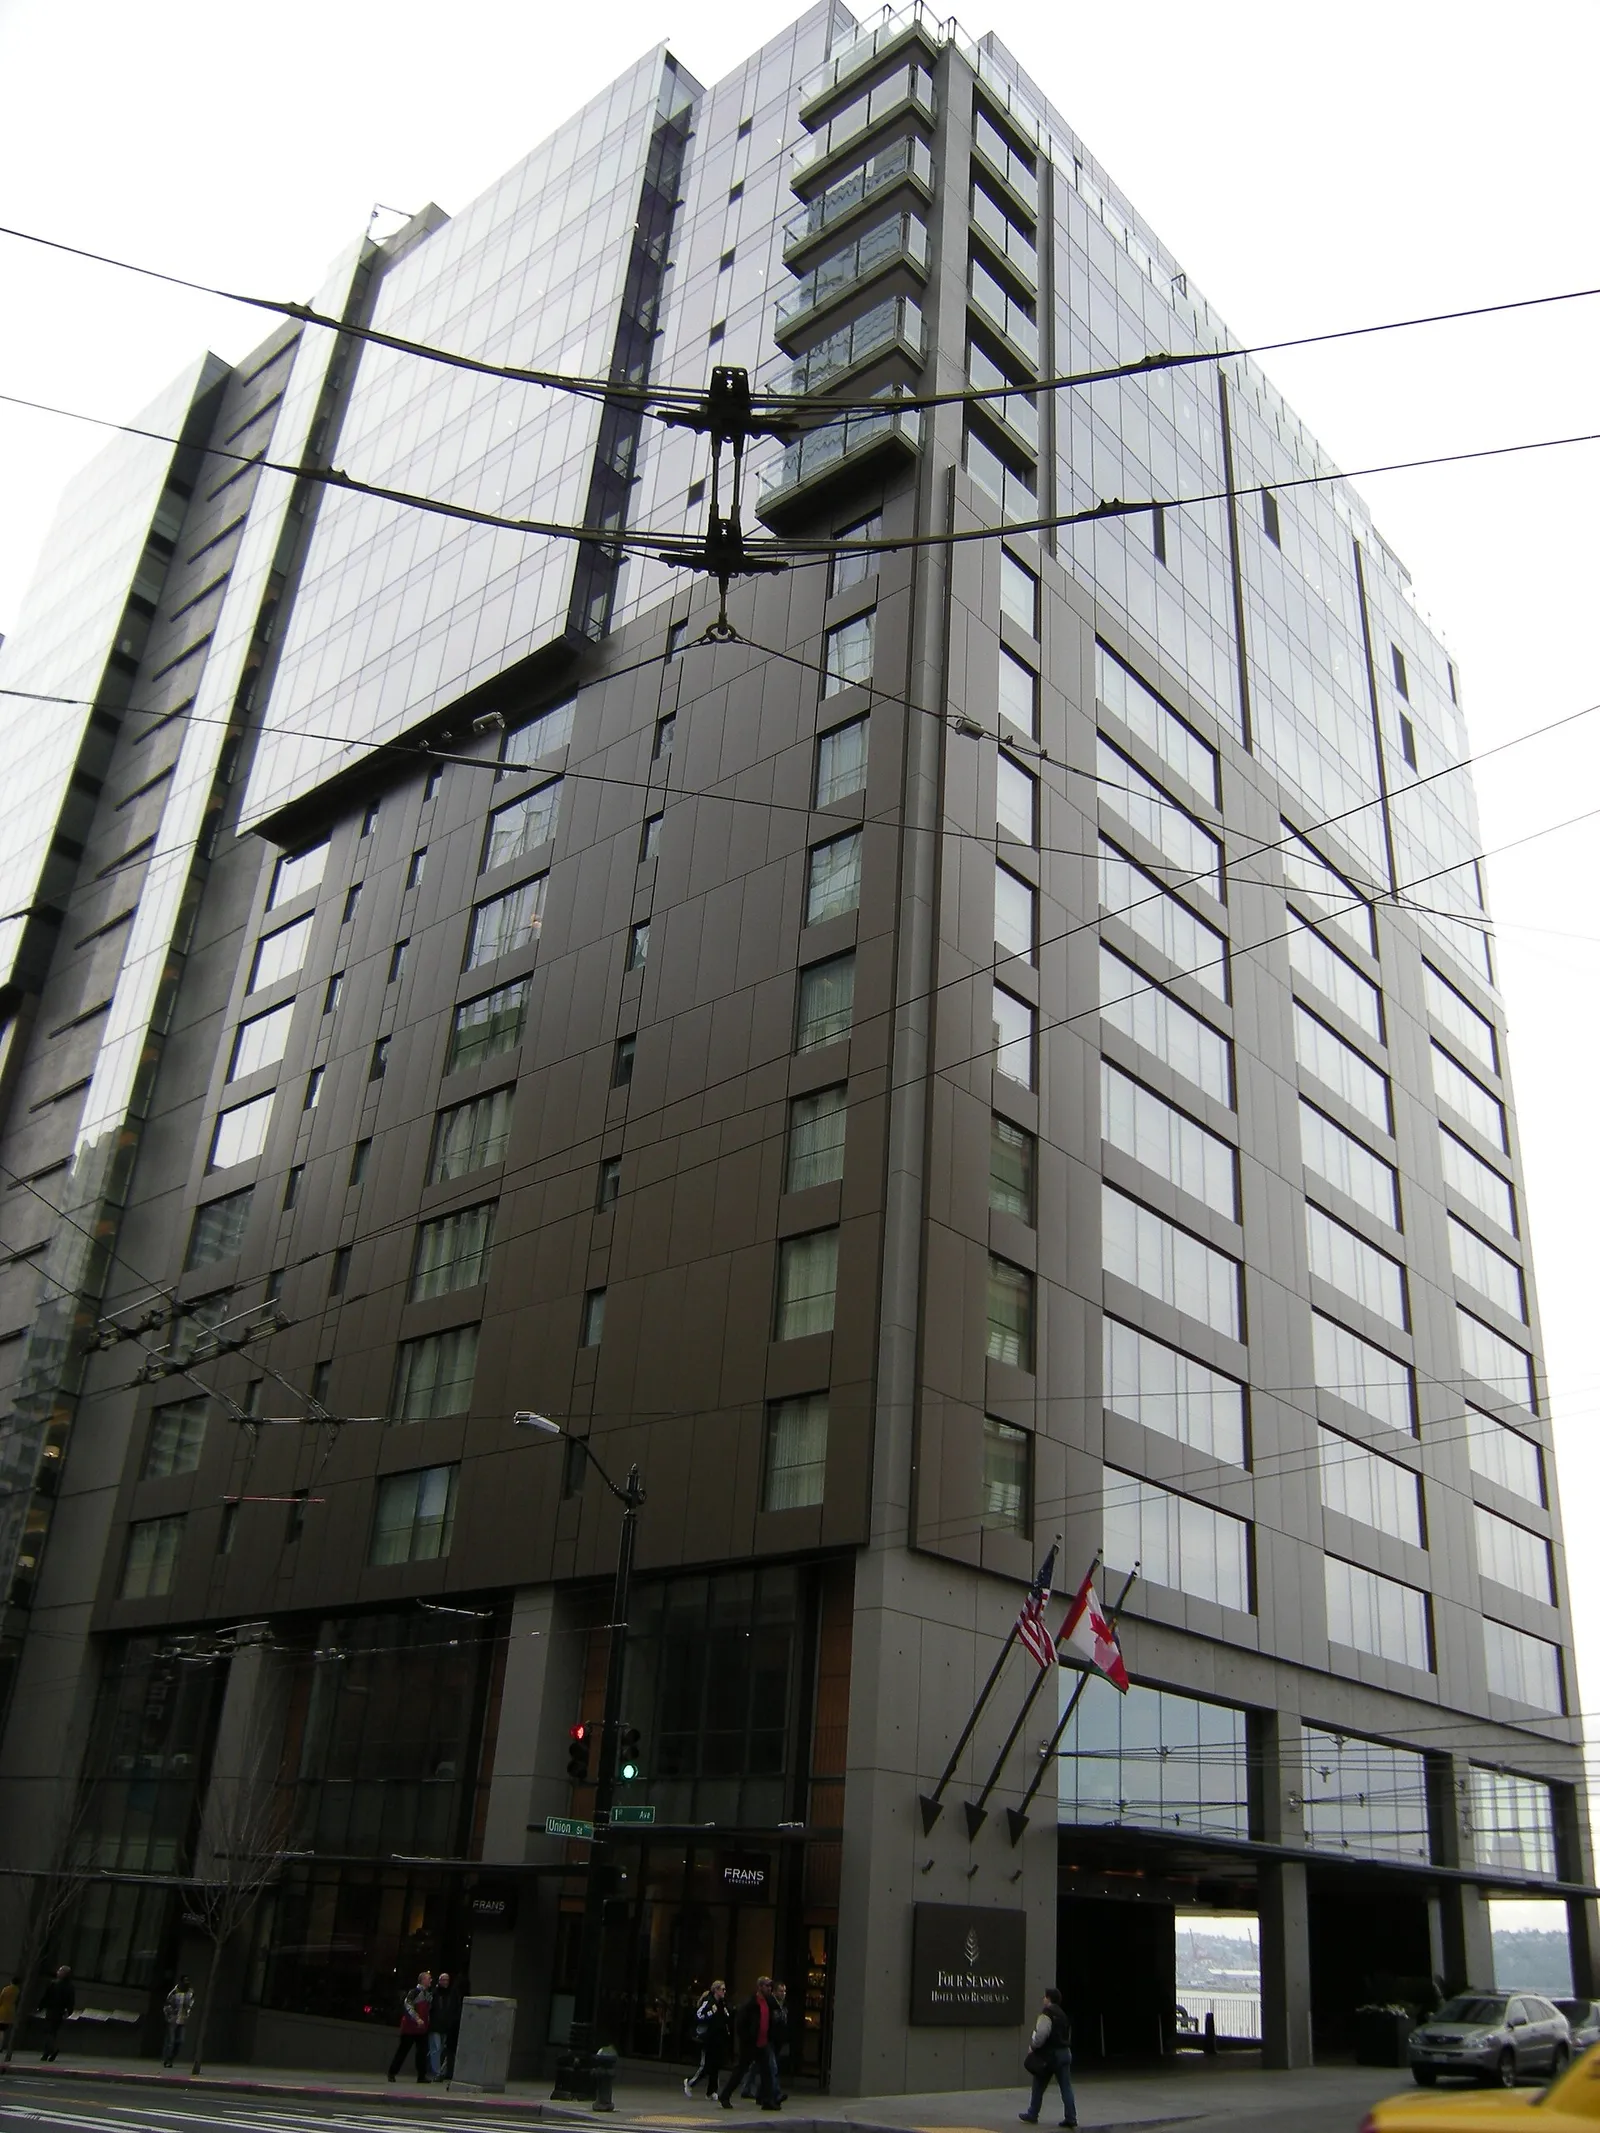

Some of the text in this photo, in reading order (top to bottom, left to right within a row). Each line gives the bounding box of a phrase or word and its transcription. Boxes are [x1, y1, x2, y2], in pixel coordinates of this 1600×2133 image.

[639, 1810, 651, 1819] Ave
[549, 1819, 571, 1834] Union
[576, 1825, 583, 1835] St
[724, 1867, 764, 1881] FRANS
[938, 1970, 963, 1987] FOUR
